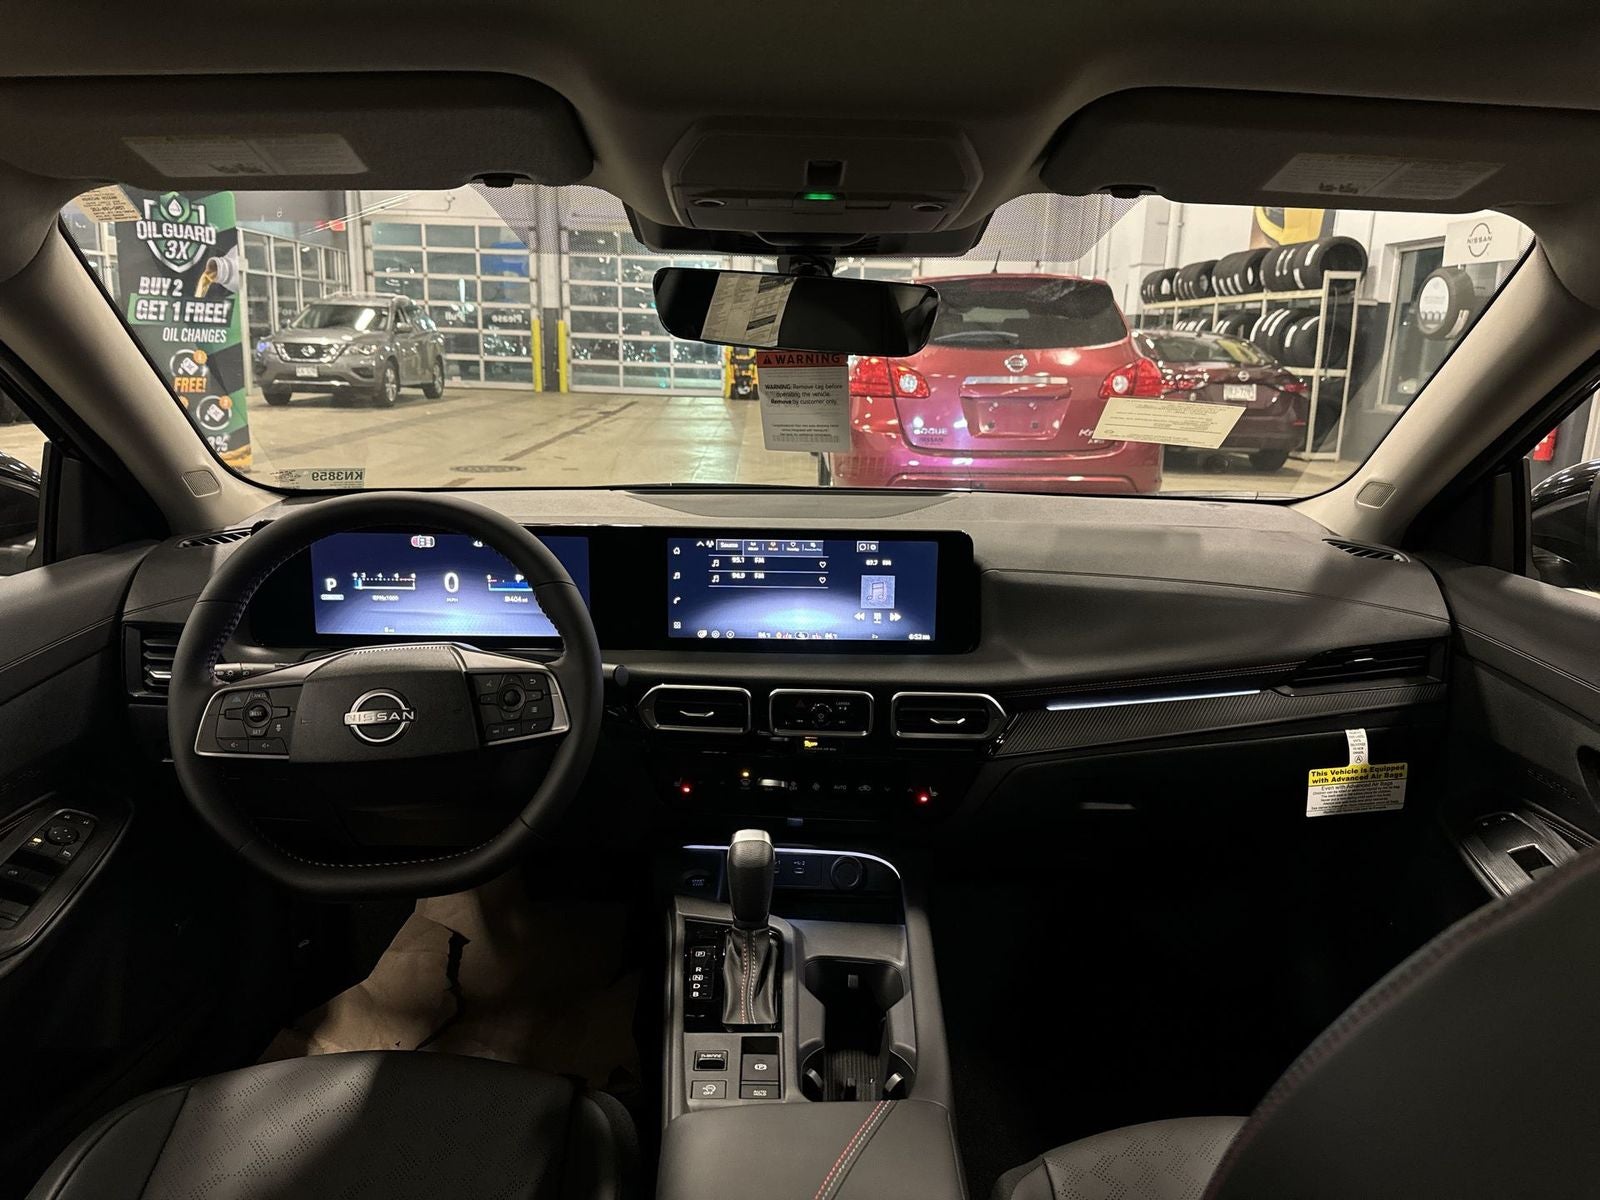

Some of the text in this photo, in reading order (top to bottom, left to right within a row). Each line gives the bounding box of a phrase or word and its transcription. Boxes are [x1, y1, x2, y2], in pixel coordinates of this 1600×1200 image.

[1467, 236, 1492, 244] NISSAN
[165, 240, 190, 260] 3X
[139, 276, 183, 297] BUY 2
[136, 299, 231, 323] GET 1 FREE!
[162, 327, 227, 344] OIL CHANGES
[776, 353, 841, 365] WARNING
[174, 376, 207, 393] FREE!
[325, 577, 337, 592] P
[444, 572, 459, 593] 0
[344, 711, 415, 723] NISSAN
[1330, 769, 1359, 777] Vehicle
[1370, 764, 1405, 774] Equipped
[1331, 774, 1369, 783] Advanced
[1384, 772, 1403, 780] Bags
